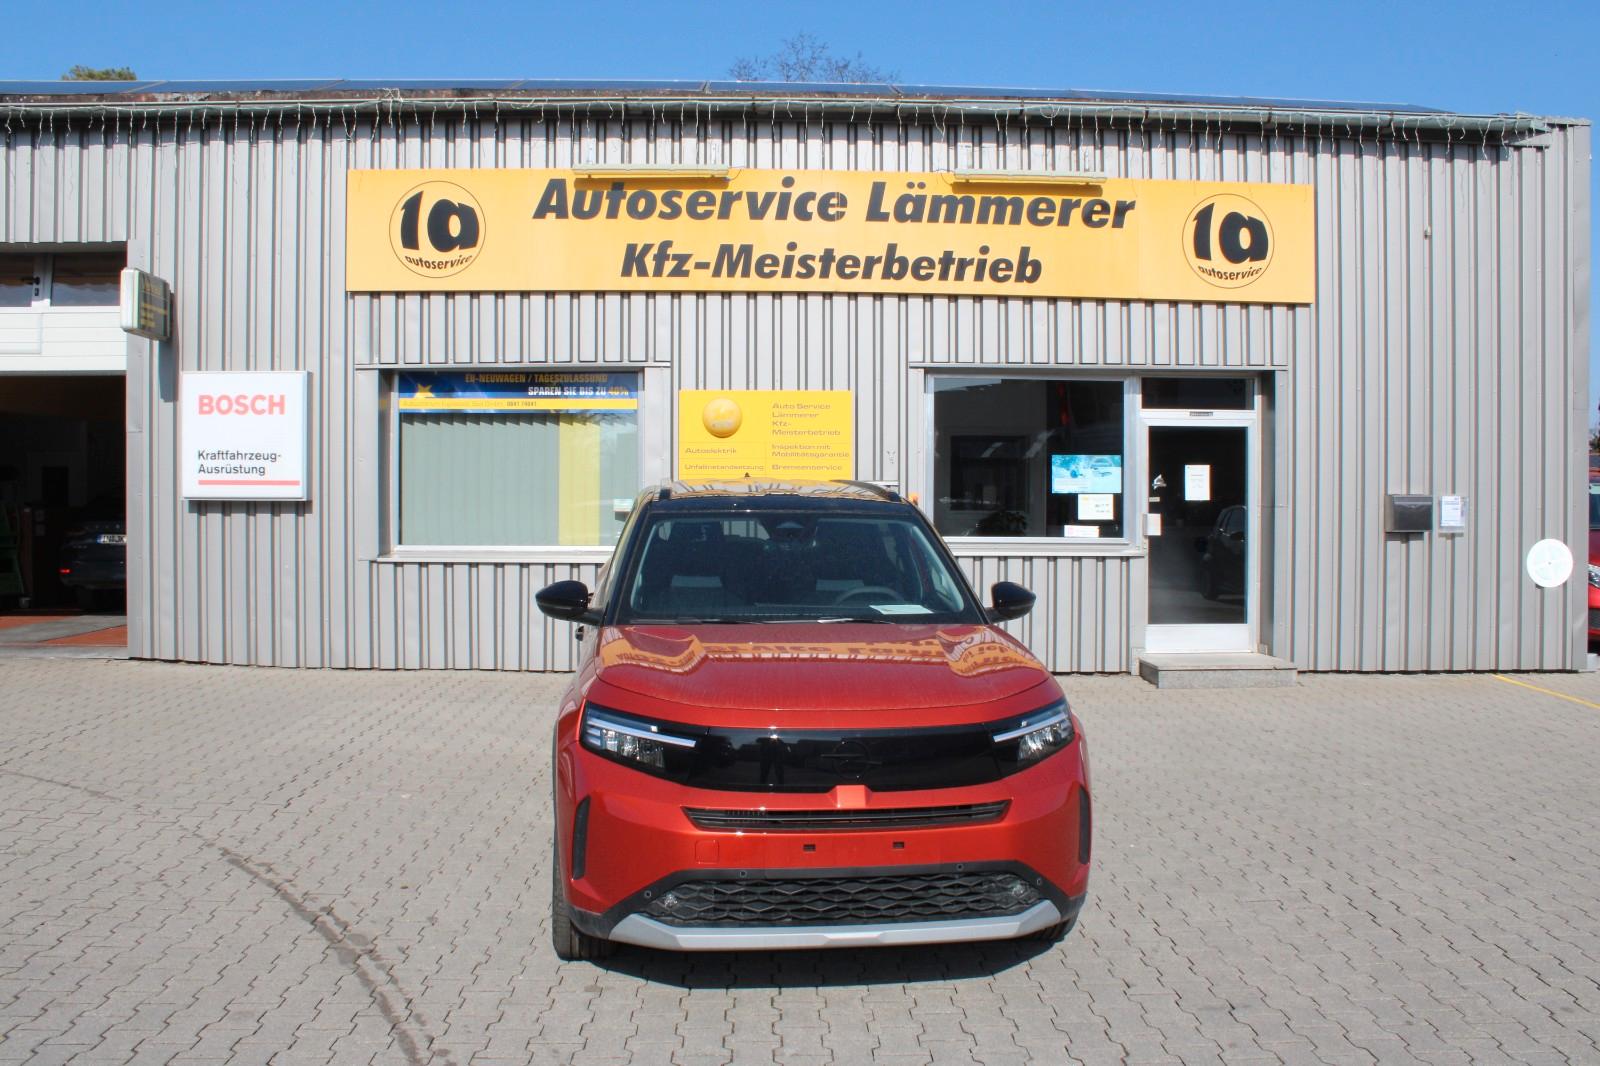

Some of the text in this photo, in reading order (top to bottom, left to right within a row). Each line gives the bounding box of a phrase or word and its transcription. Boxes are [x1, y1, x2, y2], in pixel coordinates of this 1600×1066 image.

[532, 176, 1136, 229] Autoservice Lämmerer
[400, 190, 480, 253] 1a
[1193, 202, 1269, 264] 1a
[404, 254, 473, 270] autoservice
[621, 240, 1042, 284] Kfz-Meisterbetrieb
[1197, 265, 1262, 280] autoservice
[528, 386, 561, 396] SPAREN
[563, 386, 577, 396] SIE
[579, 386, 594, 396] BIS
[596, 386, 606, 396] ZU
[198, 394, 285, 415] BOSCH
[772, 402, 831, 410] Auto Service
[198, 450, 281, 464] Kraftfahrzeug-
[198, 463, 266, 476] Ausrüstung
